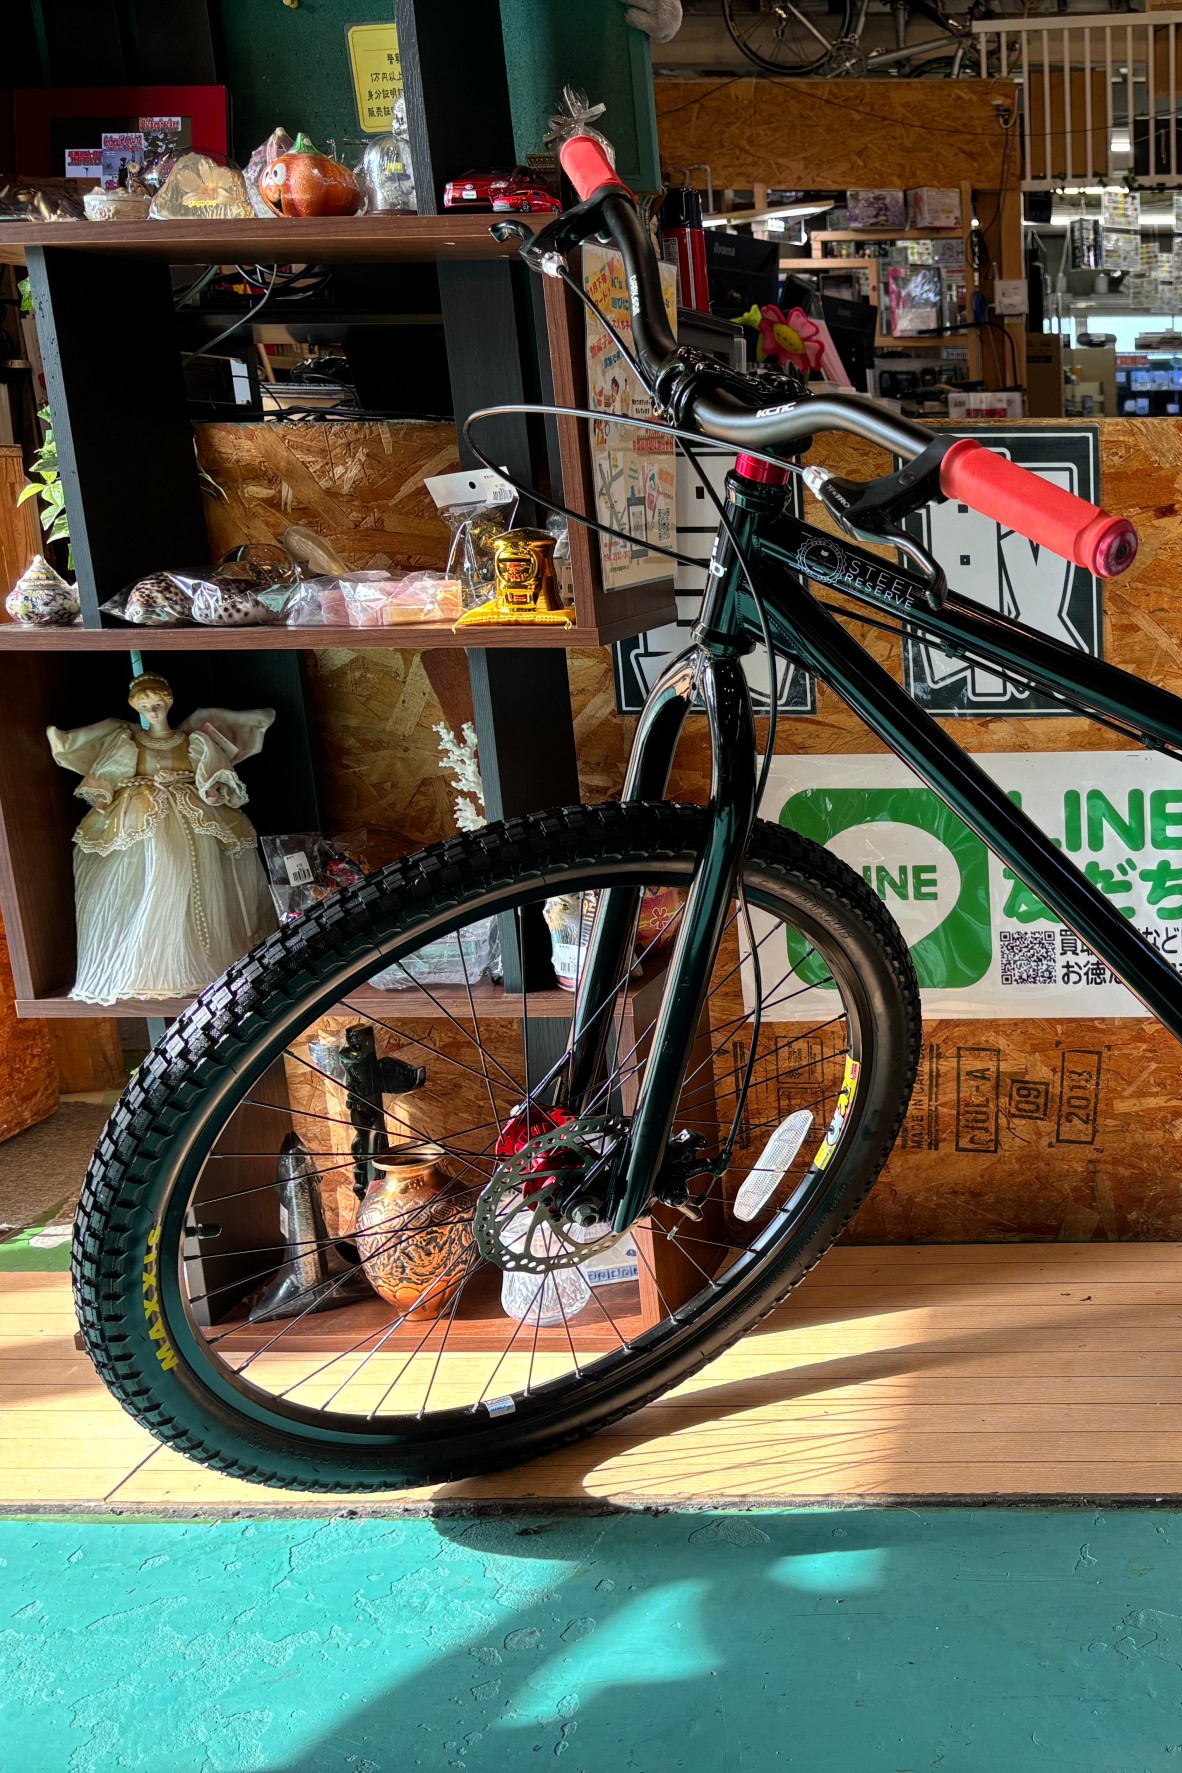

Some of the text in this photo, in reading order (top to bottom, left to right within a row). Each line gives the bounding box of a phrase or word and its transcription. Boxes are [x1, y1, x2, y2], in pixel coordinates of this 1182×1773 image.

[755, 402, 797, 419] KCNC
[845, 572, 914, 611] RESERVE
[849, 560, 915, 601] STEEL
[862, 865, 937, 901] INE
[1064, 1069, 1095, 1126] 2013
[910, 1114, 925, 1149] MADE
[142, 1225, 179, 1371] MAXXIS
